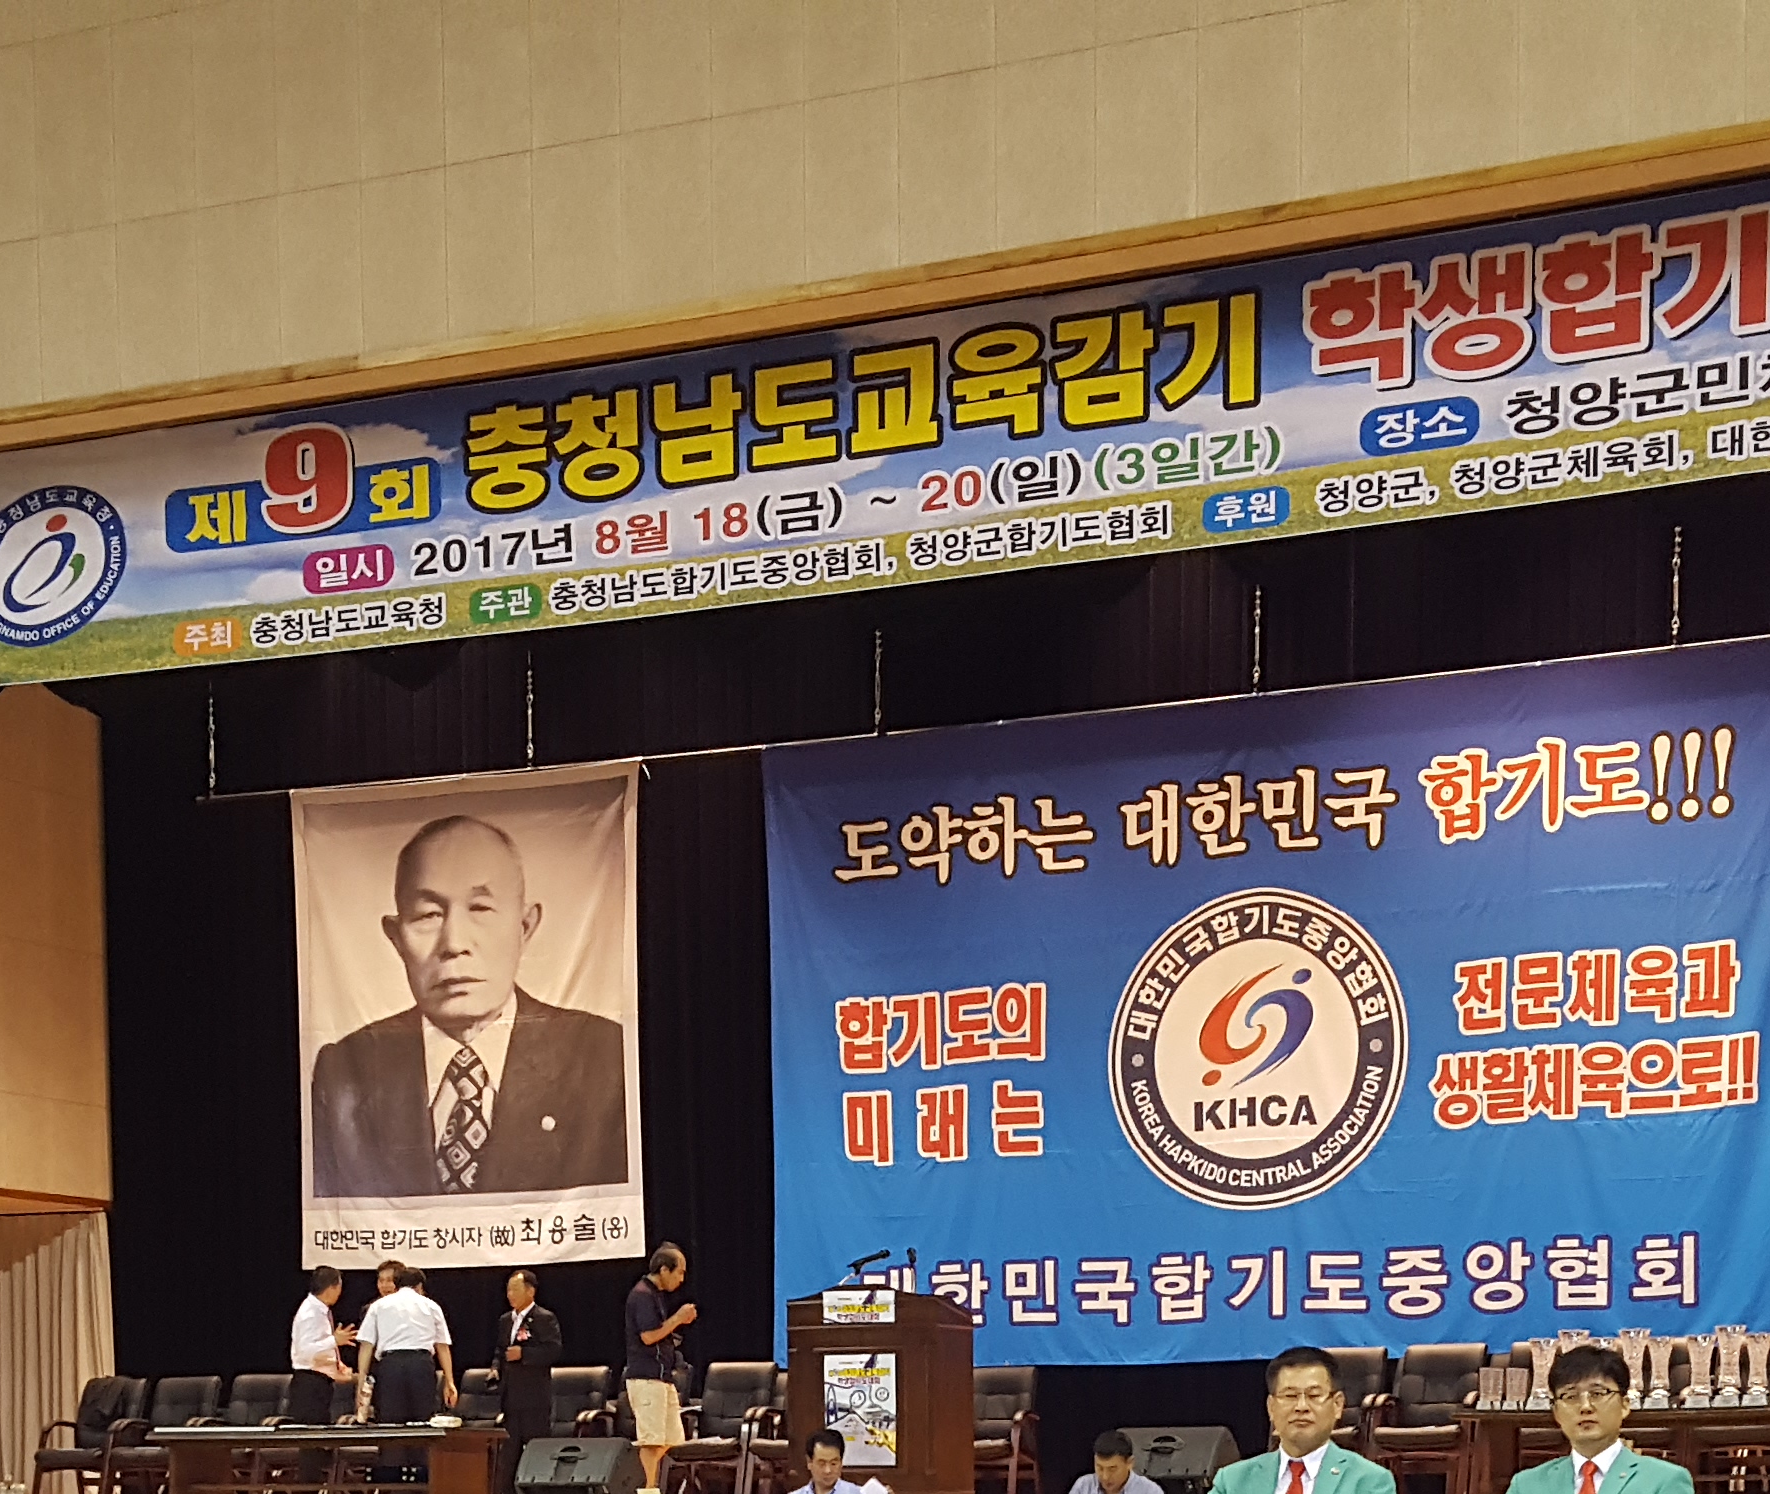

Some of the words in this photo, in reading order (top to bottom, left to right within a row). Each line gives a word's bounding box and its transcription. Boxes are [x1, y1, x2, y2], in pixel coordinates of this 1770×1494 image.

[464, 293, 1262, 514] 충청남도교육감기
[183, 622, 234, 652] 주최
[249, 597, 448, 648] 충청남도교육청
[477, 588, 535, 620] 주관
[548, 541, 896, 615] 충청남도합기도중앙협회,
[909, 505, 1172, 570] 청양군합기도협회
[1212, 492, 1280, 526] 후원
[1316, 473, 1438, 515] 청양군,
[1454, 437, 1692, 500] 청양군체육회,
[314, 552, 385, 588] 일시
[412, 517, 575, 580] 2017년
[591, 507, 670, 558] 8월
[693, 488, 844, 549] 18(금)
[1372, 407, 1471, 447] 장소
[42, 613, 81, 640] OFFICE
[81, 600, 97, 616] OF
[95, 535, 121, 600] EDUCATION
[833, 796, 1095, 884] 도약하는
[1119, 766, 1398, 869] 대한민국
[1417, 723, 1735, 845] 합기도!!!
[1127, 904, 1389, 1040] 대한민국합기도중앙협회
[1452, 938, 1741, 1035] 전문체육과
[834, 981, 1047, 1073] 합기도의
[842, 1081, 1044, 1167] 미래는
[1130, 1079, 1161, 1142] KOREA
[1158, 1134, 1227, 1184] HAPKIDO
[1228, 1160, 1311, 1188] CENTRAL
[1312, 1065, 1384, 1170] ASSOCIATION
[1193, 1094, 1317, 1132] KHCA
[1430, 1031, 1759, 1130] 생활체육으로!!
[314, 1229, 376, 1250] 대한민국
[380, 1228, 430, 1250] 합기도
[432, 1226, 483, 1249] 창시자
[489, 1225, 516, 1248] (故)
